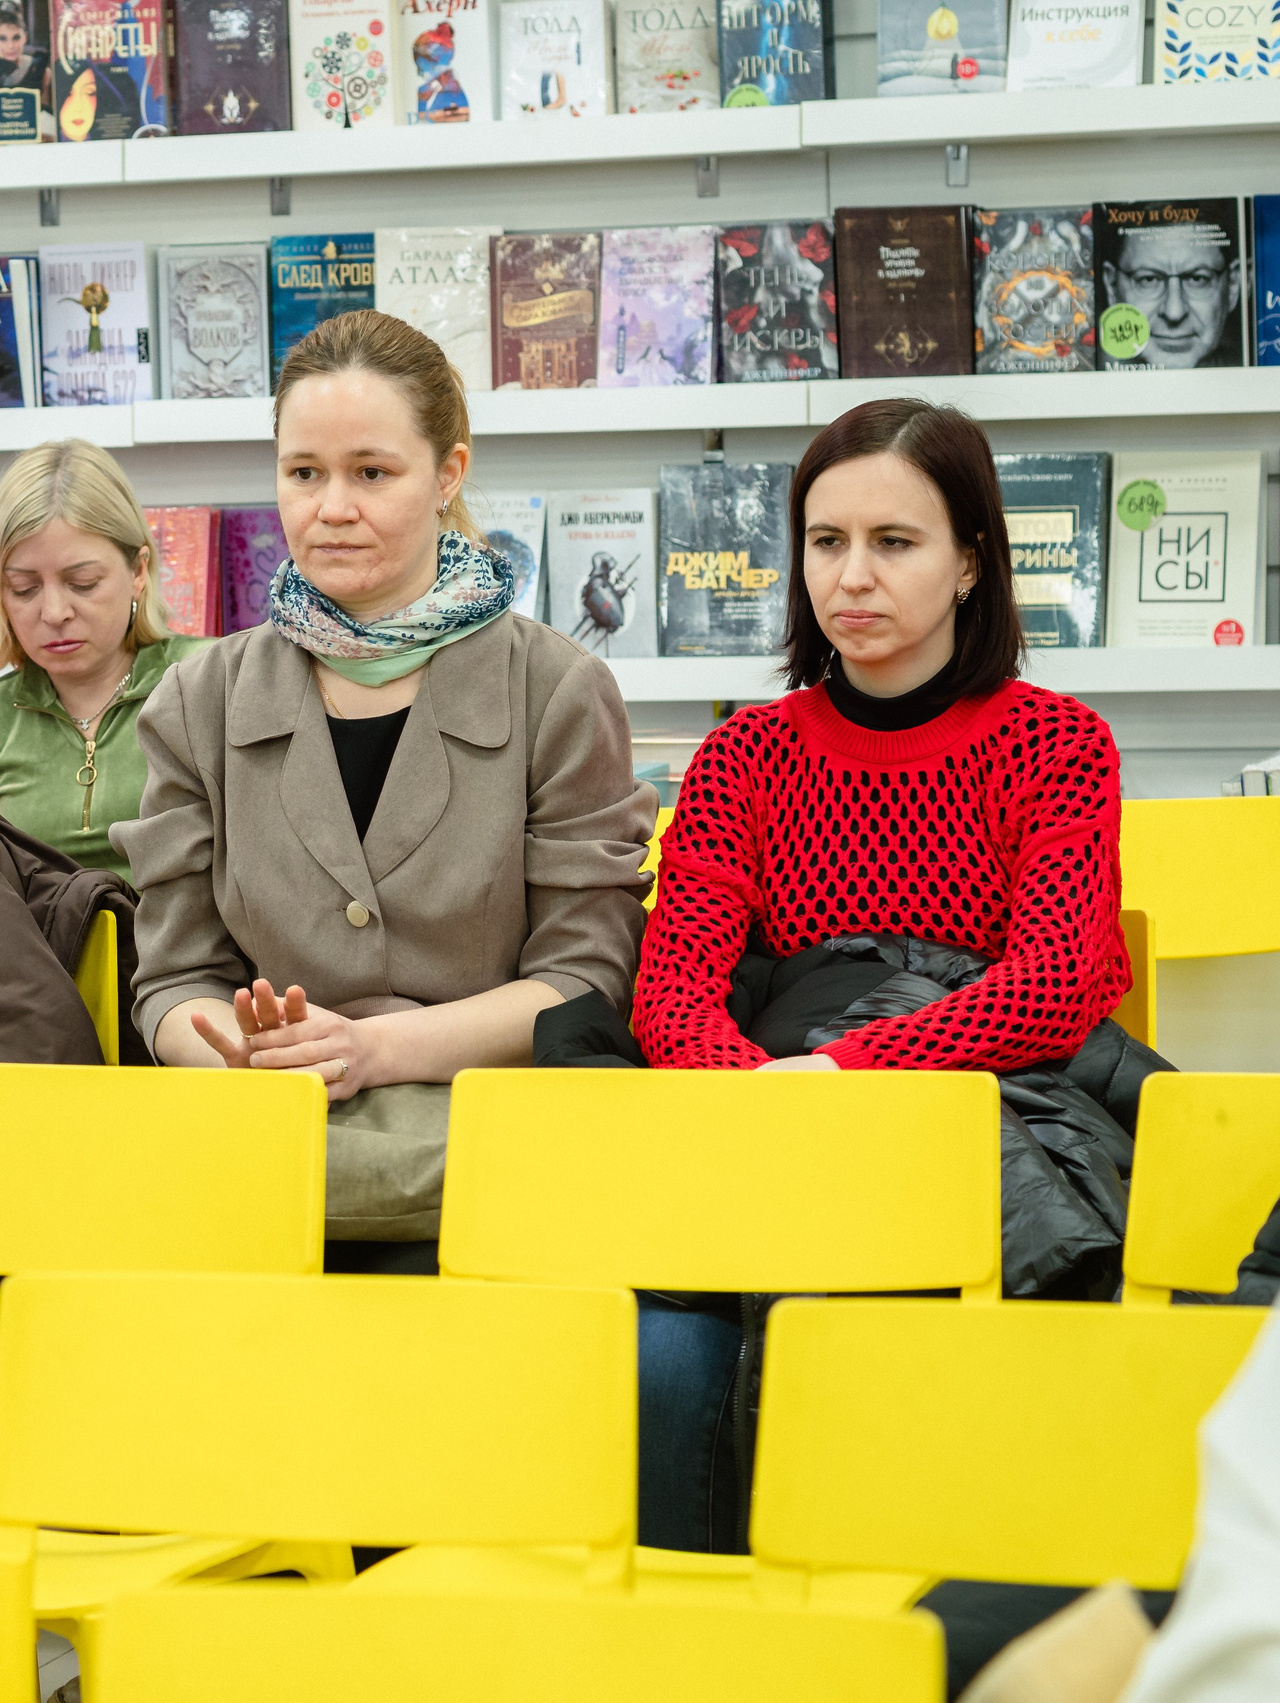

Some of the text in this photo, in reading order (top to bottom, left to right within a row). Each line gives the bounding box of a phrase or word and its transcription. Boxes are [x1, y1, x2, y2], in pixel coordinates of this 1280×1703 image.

[1020, 4, 1130, 24] Инструкция
[1184, 5, 1268, 29] COZY
[1058, 24, 1103, 43] себе
[735, 48, 811, 80] ЯРОСТЬ
[1107, 205, 1200, 226] Хочу и буду
[277, 262, 375, 289] СЛЕД КРОВ
[732, 327, 828, 352] ИСКРЫ
[559, 510, 645, 527] ДЖО АБЕРКРОМБИ
[1007, 518, 1067, 537] ЕТОД
[1158, 526, 1211, 556] НИ
[666, 551, 750, 576] ДЖИМ
[1154, 560, 1210, 590] СЫ
[684, 568, 780, 590] БАТЧЕР
